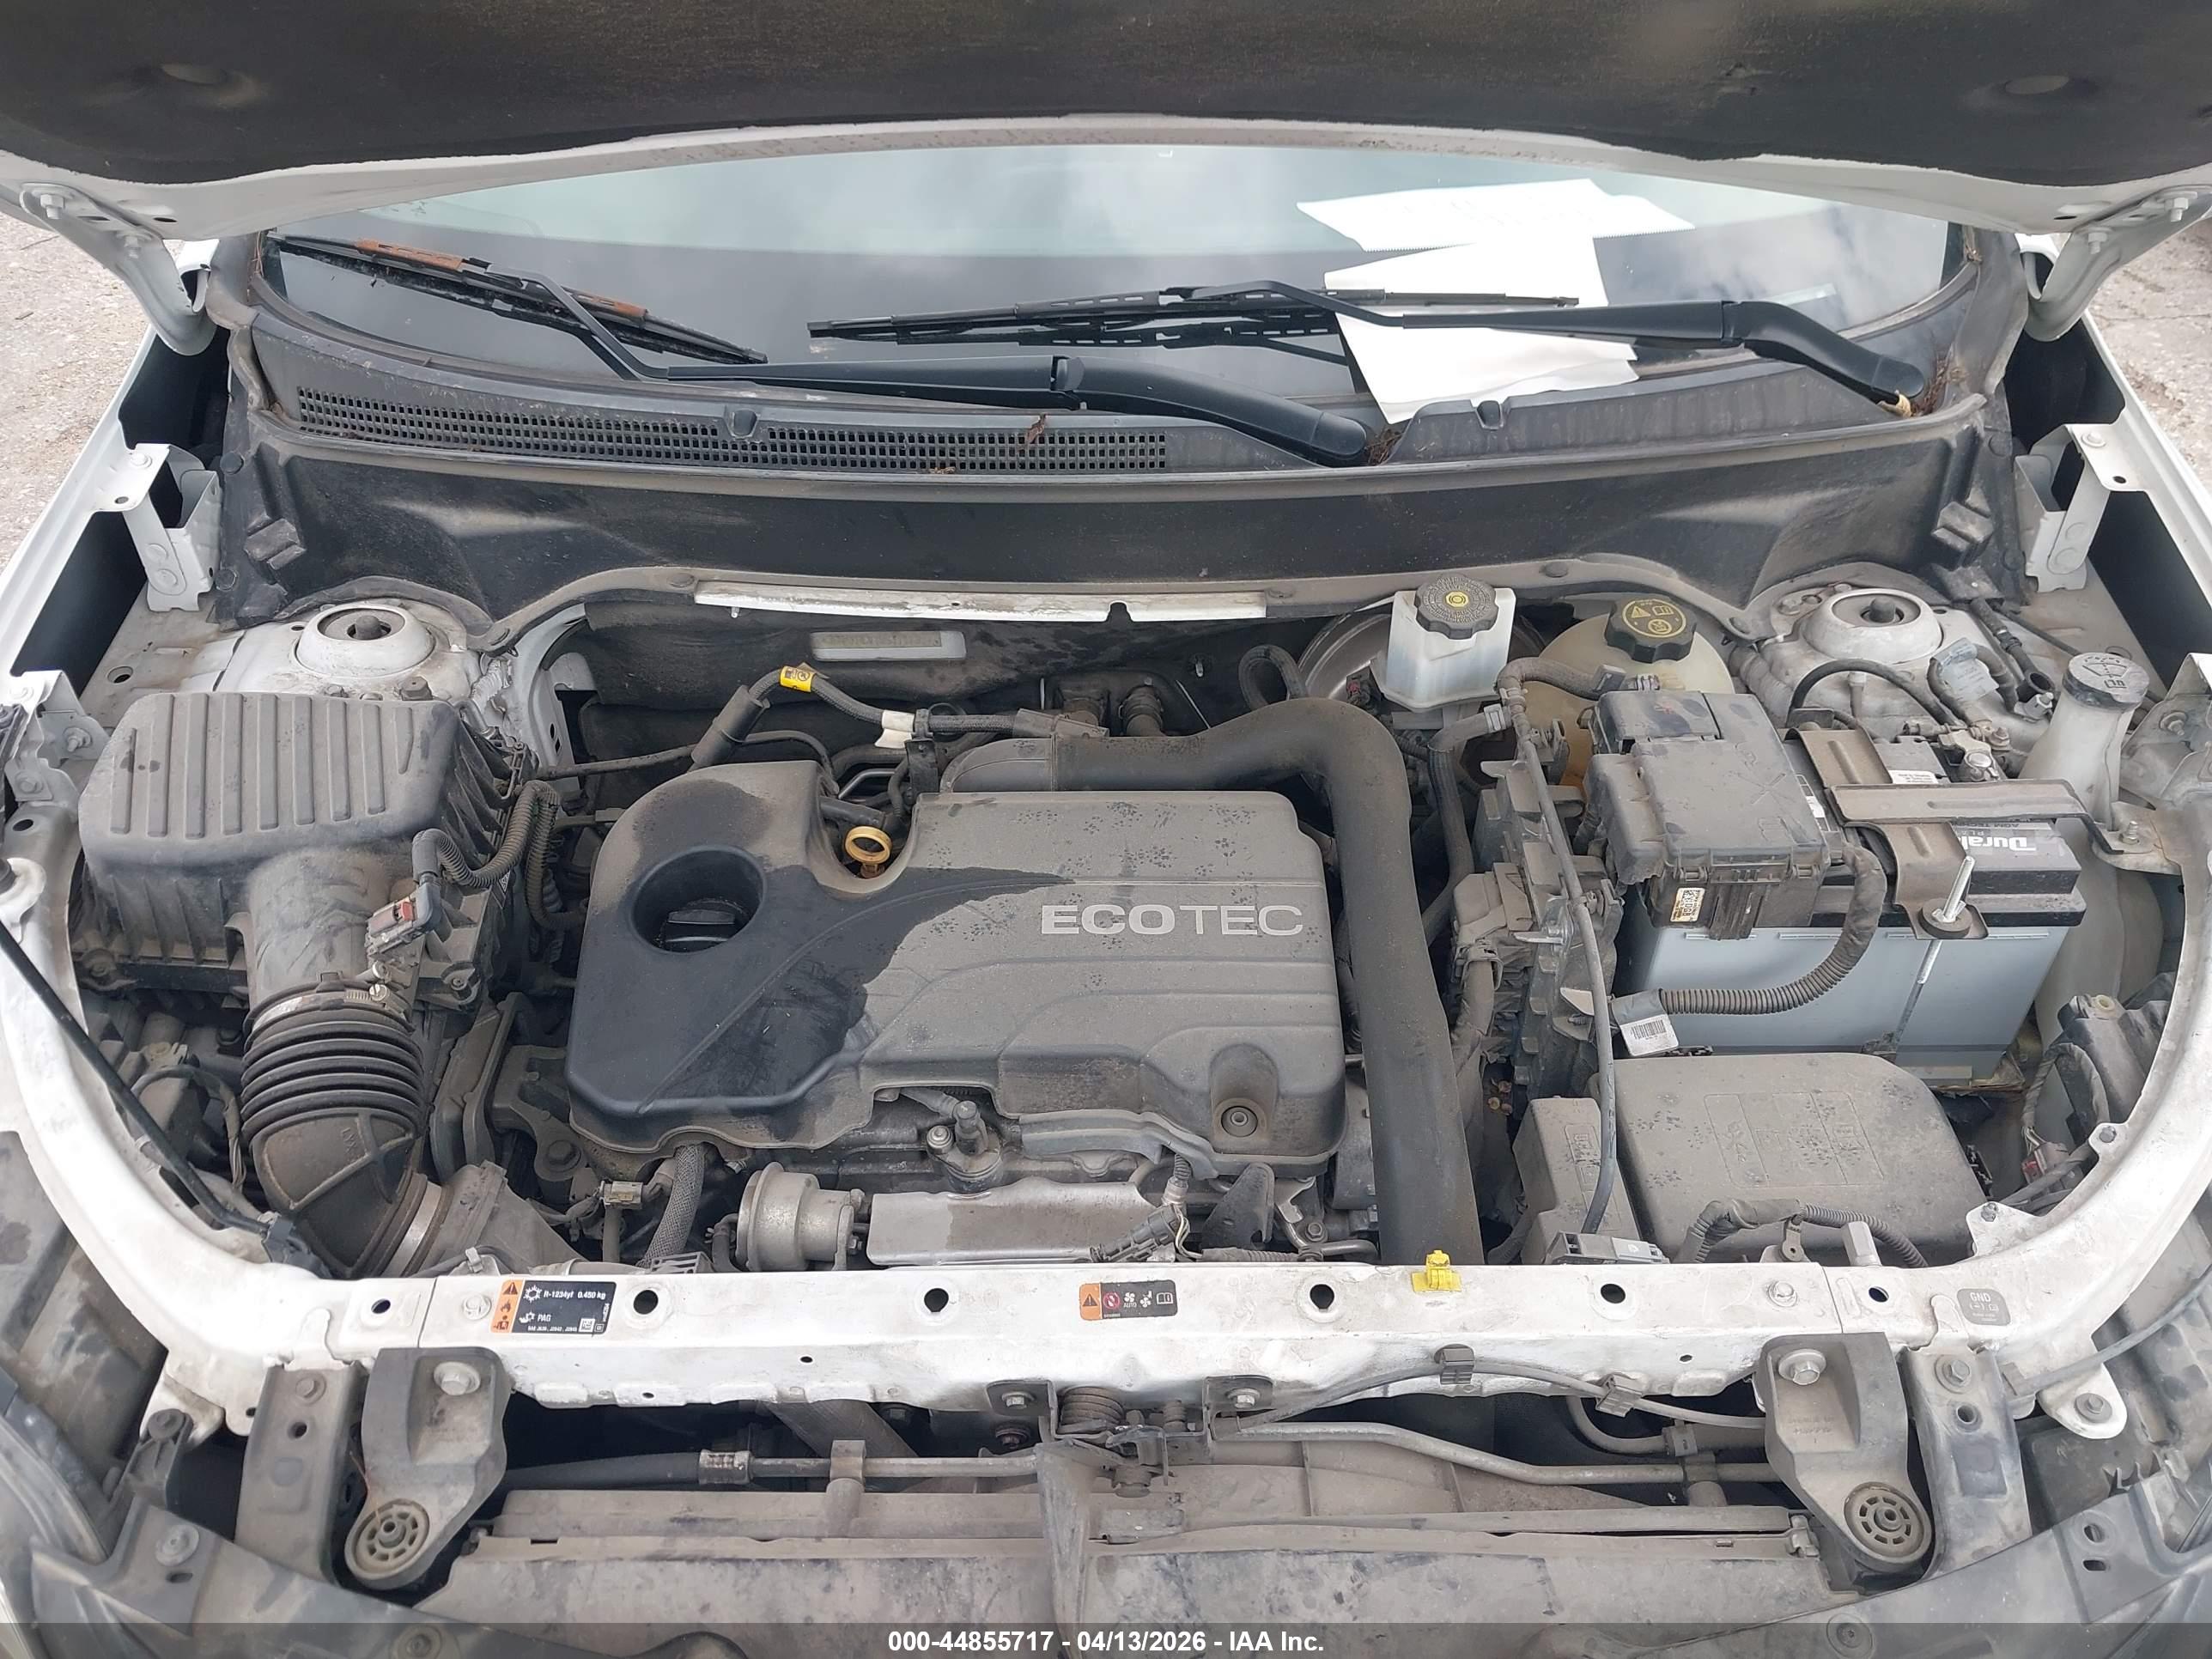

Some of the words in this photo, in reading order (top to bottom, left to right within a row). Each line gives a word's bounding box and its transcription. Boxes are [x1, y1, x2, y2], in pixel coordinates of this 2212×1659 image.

[1959, 836, 2036, 851] Dural
[1042, 904, 1304, 935] ECOTEC
[543, 1291, 574, 1299] R-1234yf
[596, 1291, 606, 1300] kg
[1970, 1292, 1990, 1302] GND
[537, 1314, 551, 1322] PAG
